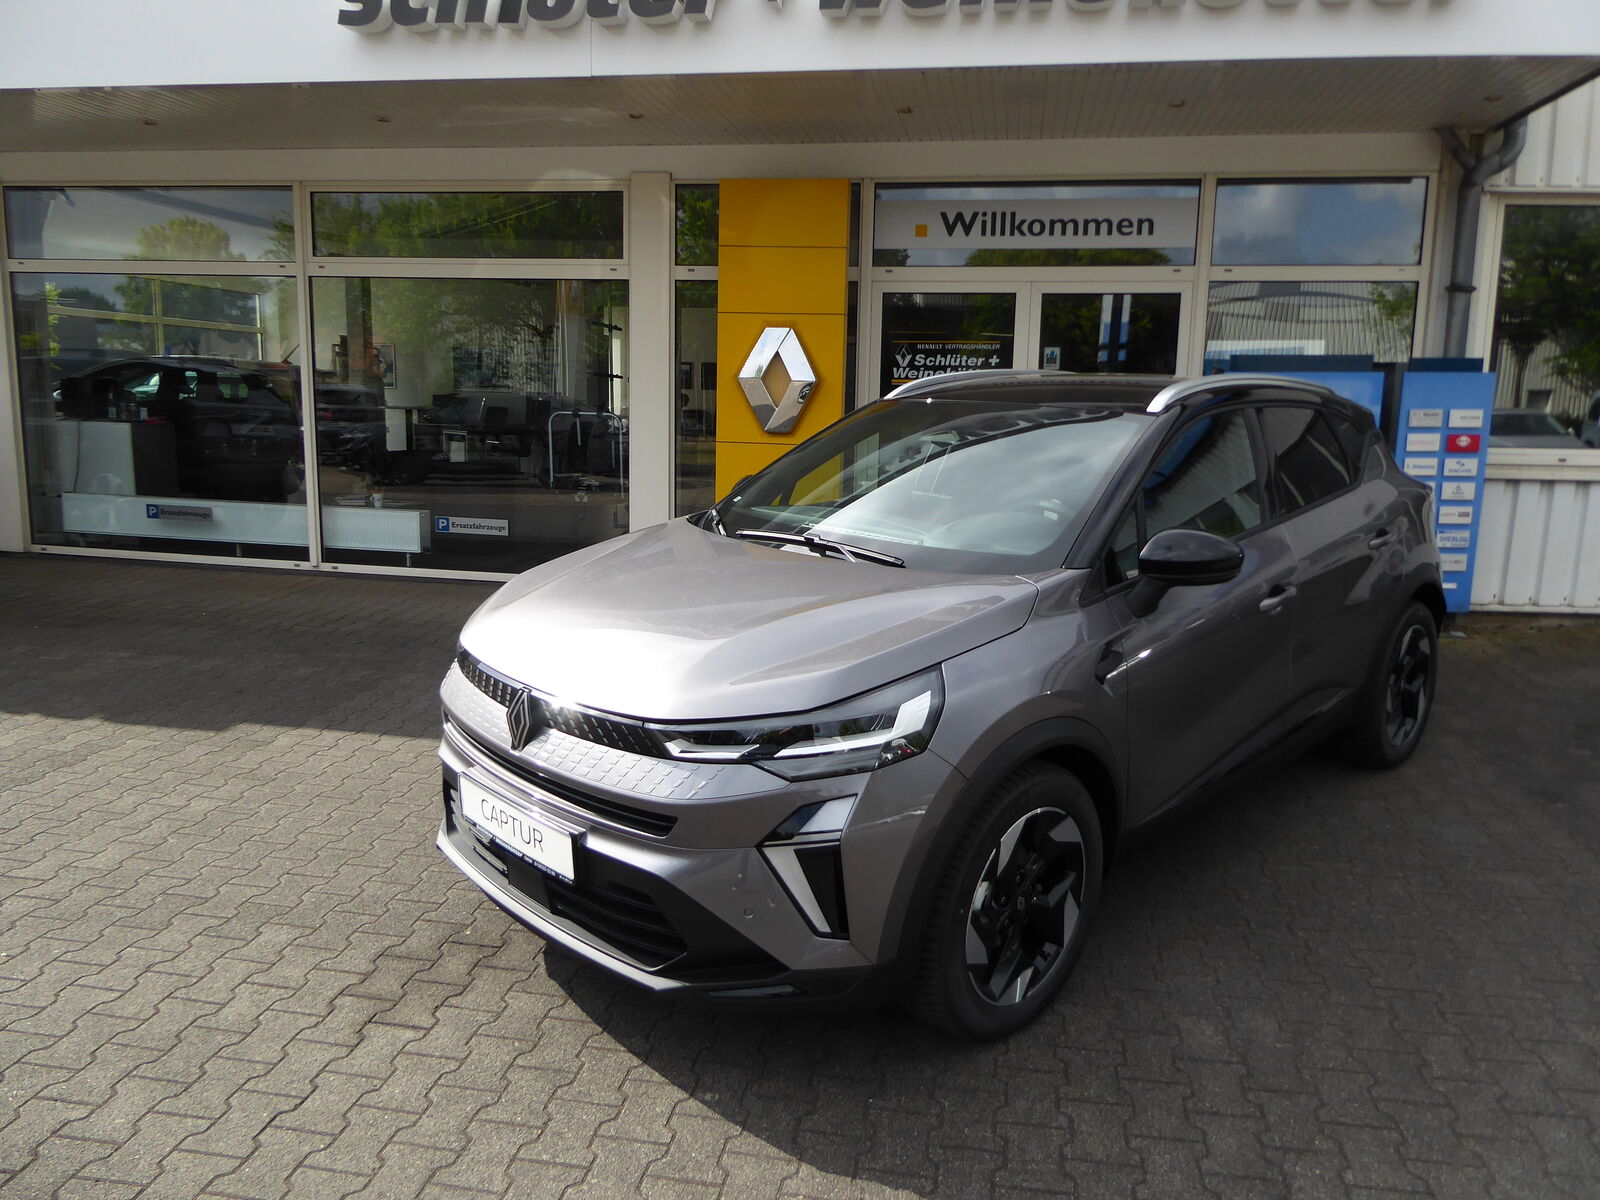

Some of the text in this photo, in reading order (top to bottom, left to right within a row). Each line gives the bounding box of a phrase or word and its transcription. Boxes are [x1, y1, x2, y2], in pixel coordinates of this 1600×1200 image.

[940, 211, 1154, 237] Willkommen
[914, 353, 985, 366] Schlüter
[438, 518, 506, 532] P Ersatzfahrzeuge
[481, 799, 543, 852] CAPTUR
